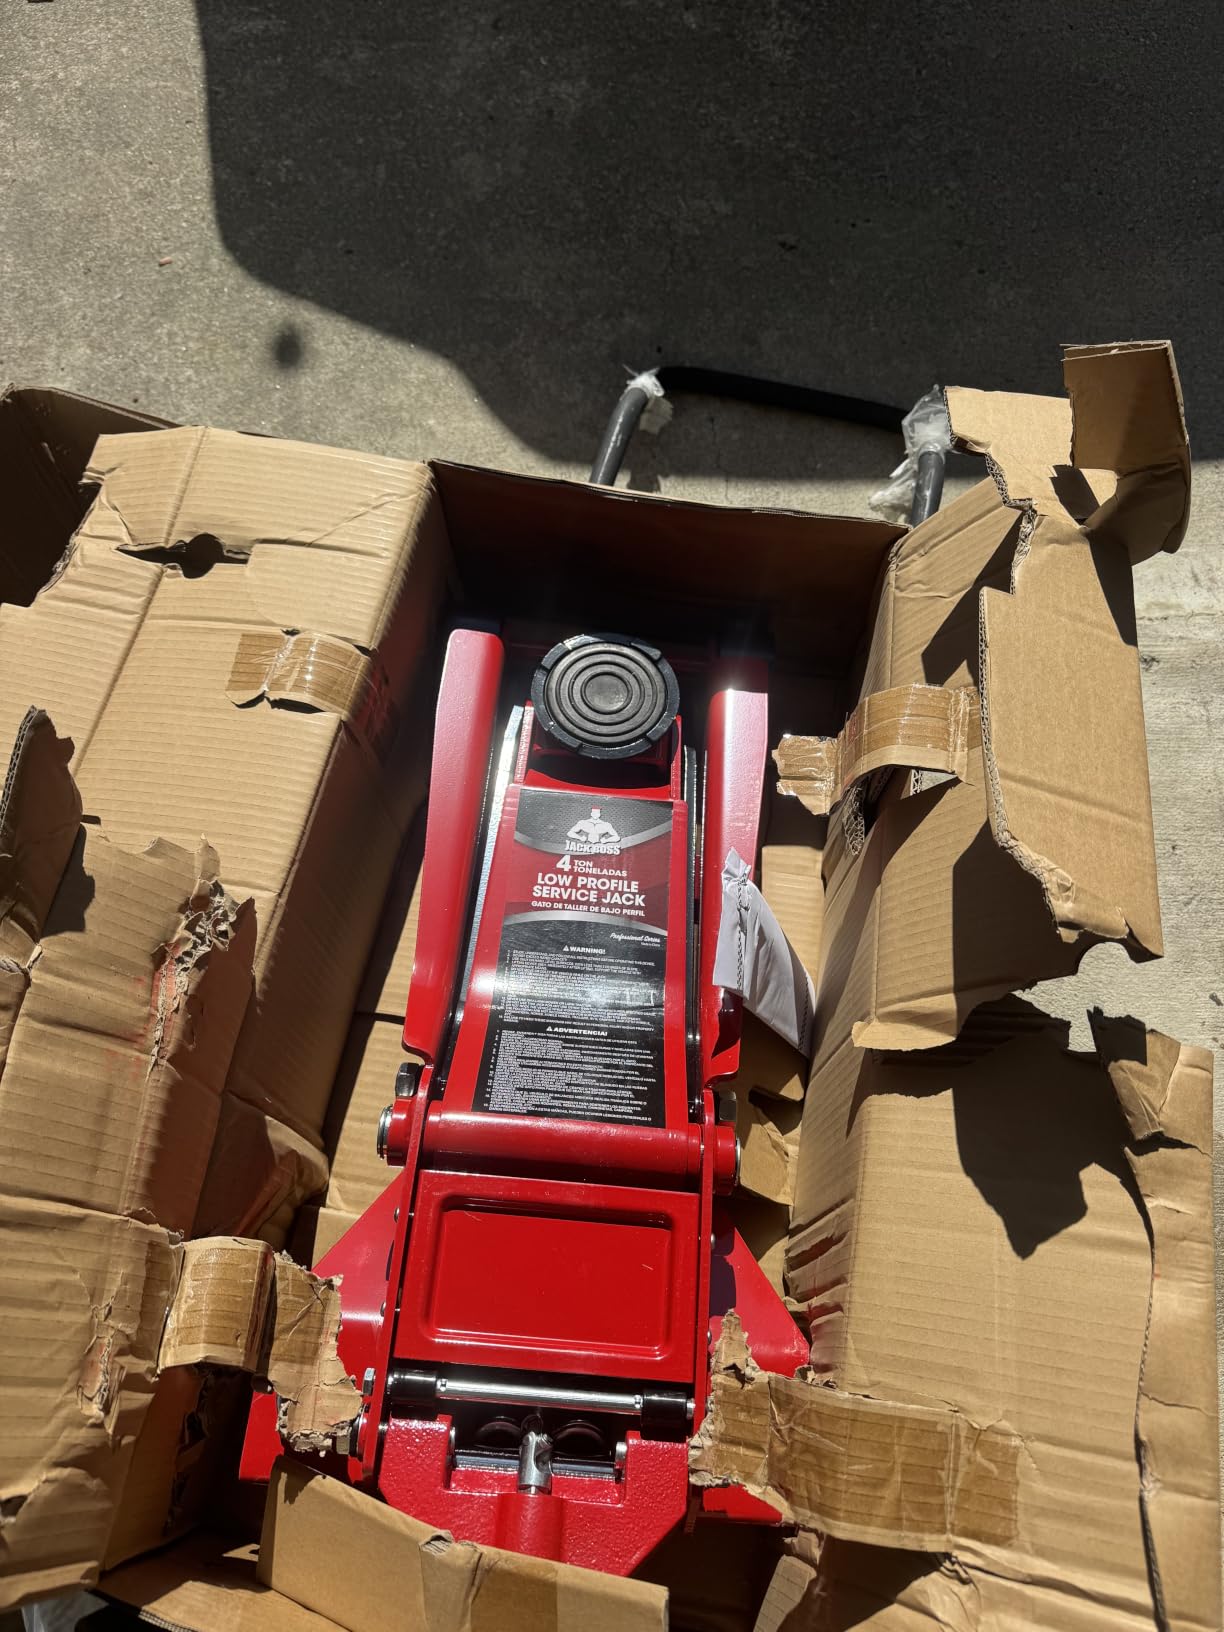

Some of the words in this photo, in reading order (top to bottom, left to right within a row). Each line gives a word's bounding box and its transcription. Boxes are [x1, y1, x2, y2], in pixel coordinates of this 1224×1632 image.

[565, 840, 592, 853] JACK
[556, 854, 571, 872] 4
[573, 866, 628, 876] TONELADAS
[537, 873, 573, 886] LOW
[577, 876, 639, 892] PROFILE
[532, 885, 598, 902] SERVICE
[602, 892, 646, 907] JACK
[531, 901, 552, 909] GATO
[564, 903, 588, 912] TALLER
[589, 905, 599, 913] DE
[600, 906, 621, 915] BAJO
[622, 908, 646, 917] PERFIL
[609, 932, 644, 942] Professional
[569, 946, 606, 955] WARNING!
[553, 1027, 608, 1037] ADVERTENCIA!
